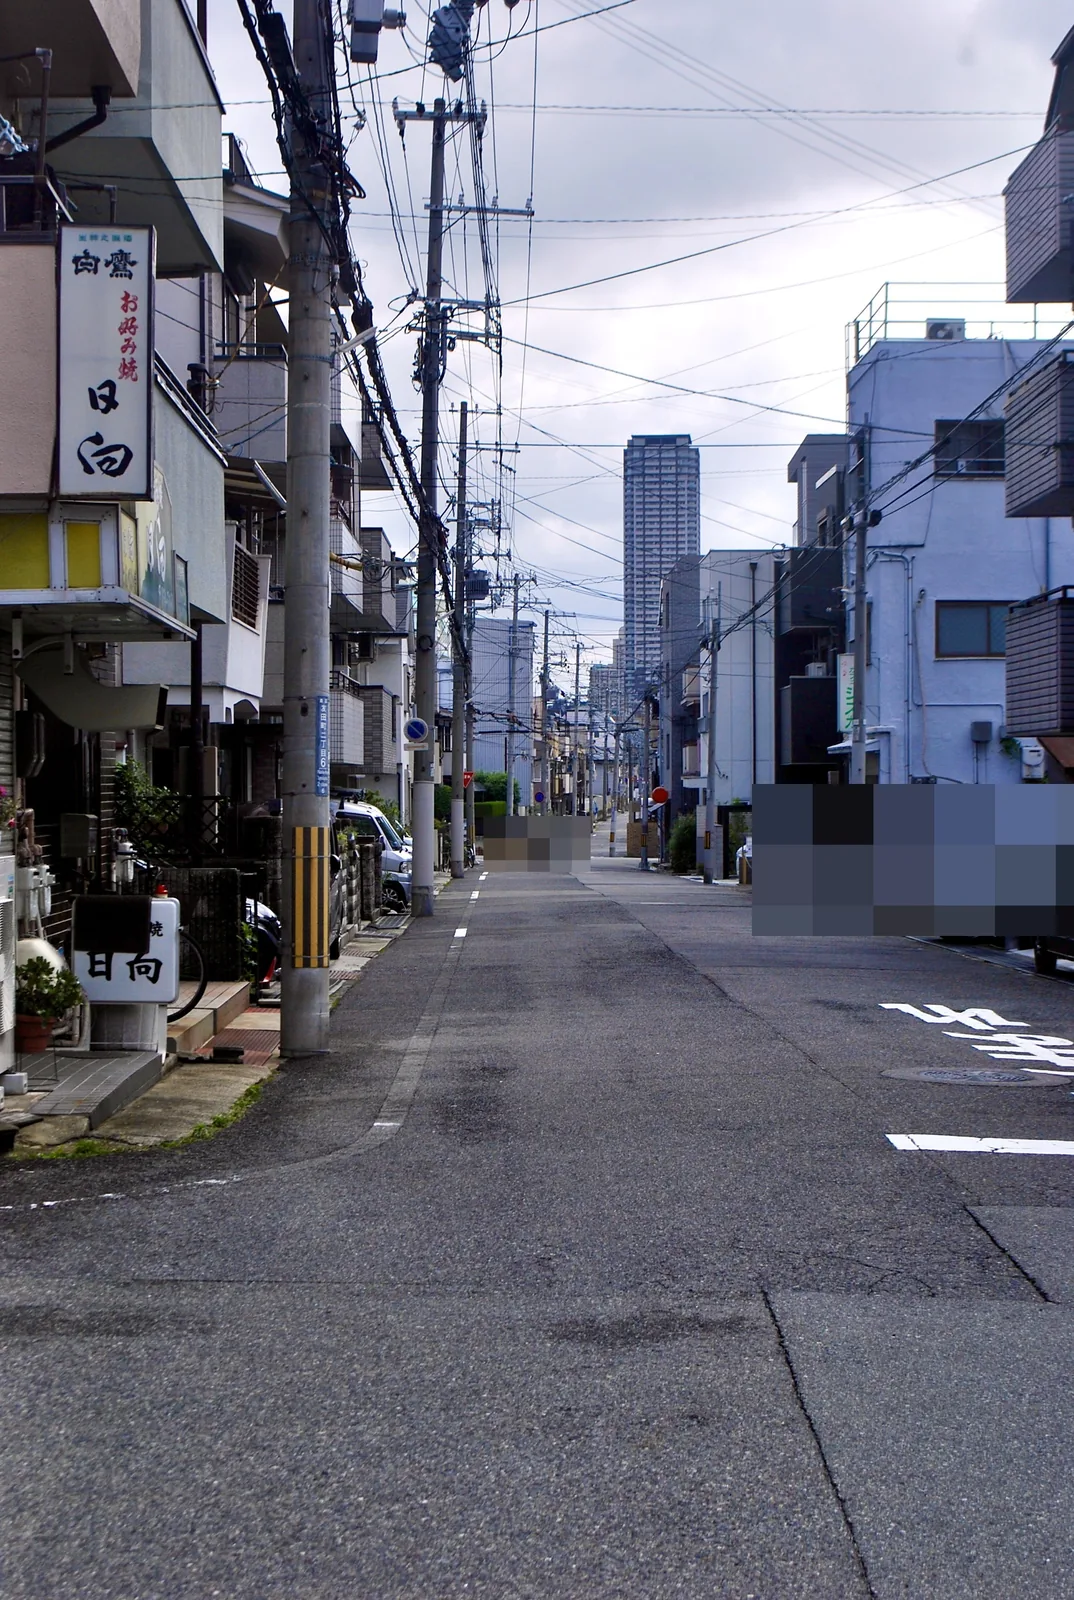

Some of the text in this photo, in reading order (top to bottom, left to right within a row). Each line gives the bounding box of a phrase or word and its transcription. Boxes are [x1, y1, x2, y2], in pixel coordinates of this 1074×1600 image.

[118, 290, 139, 382] お好み焼
[77, 379, 134, 478] 日向
[86, 951, 163, 985] 日向
